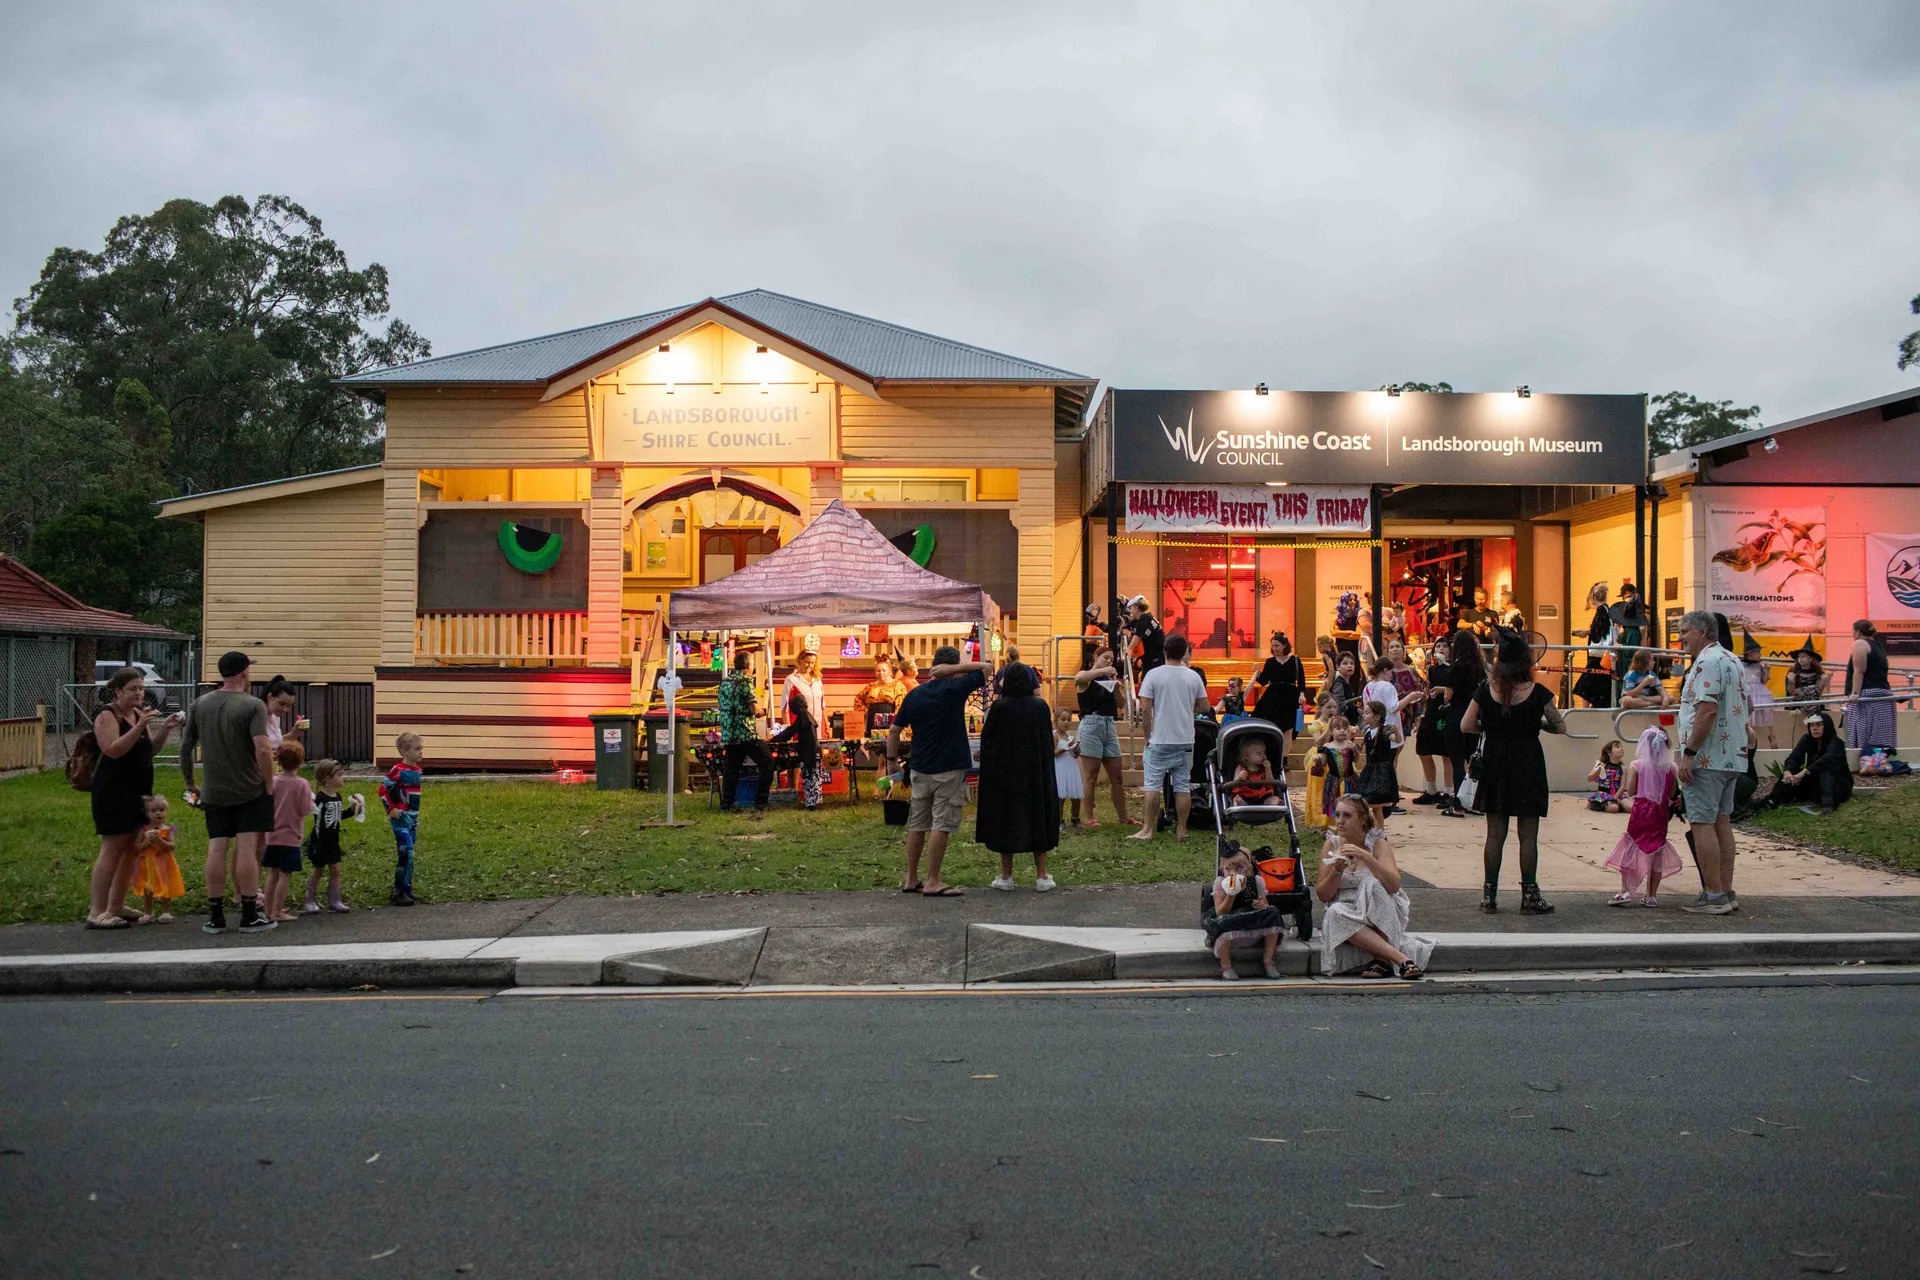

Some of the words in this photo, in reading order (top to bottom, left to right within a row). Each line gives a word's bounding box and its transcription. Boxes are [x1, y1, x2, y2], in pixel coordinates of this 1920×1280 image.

[632, 406, 798, 425] LANDSBOROUGH
[642, 432, 699, 449] SHIRE
[1216, 430, 1310, 450] Sunshine
[1313, 431, 1372, 450] Coast
[1401, 436, 1525, 456] Landsborough
[1529, 438, 1603, 453] Museum
[1217, 452, 1284, 466] COUNCIL
[1129, 489, 1219, 520] HALLOWEEN
[1272, 492, 1309, 523] THIS
[1316, 497, 1369, 528] FRIDAY
[1220, 500, 1268, 531] EVENT
